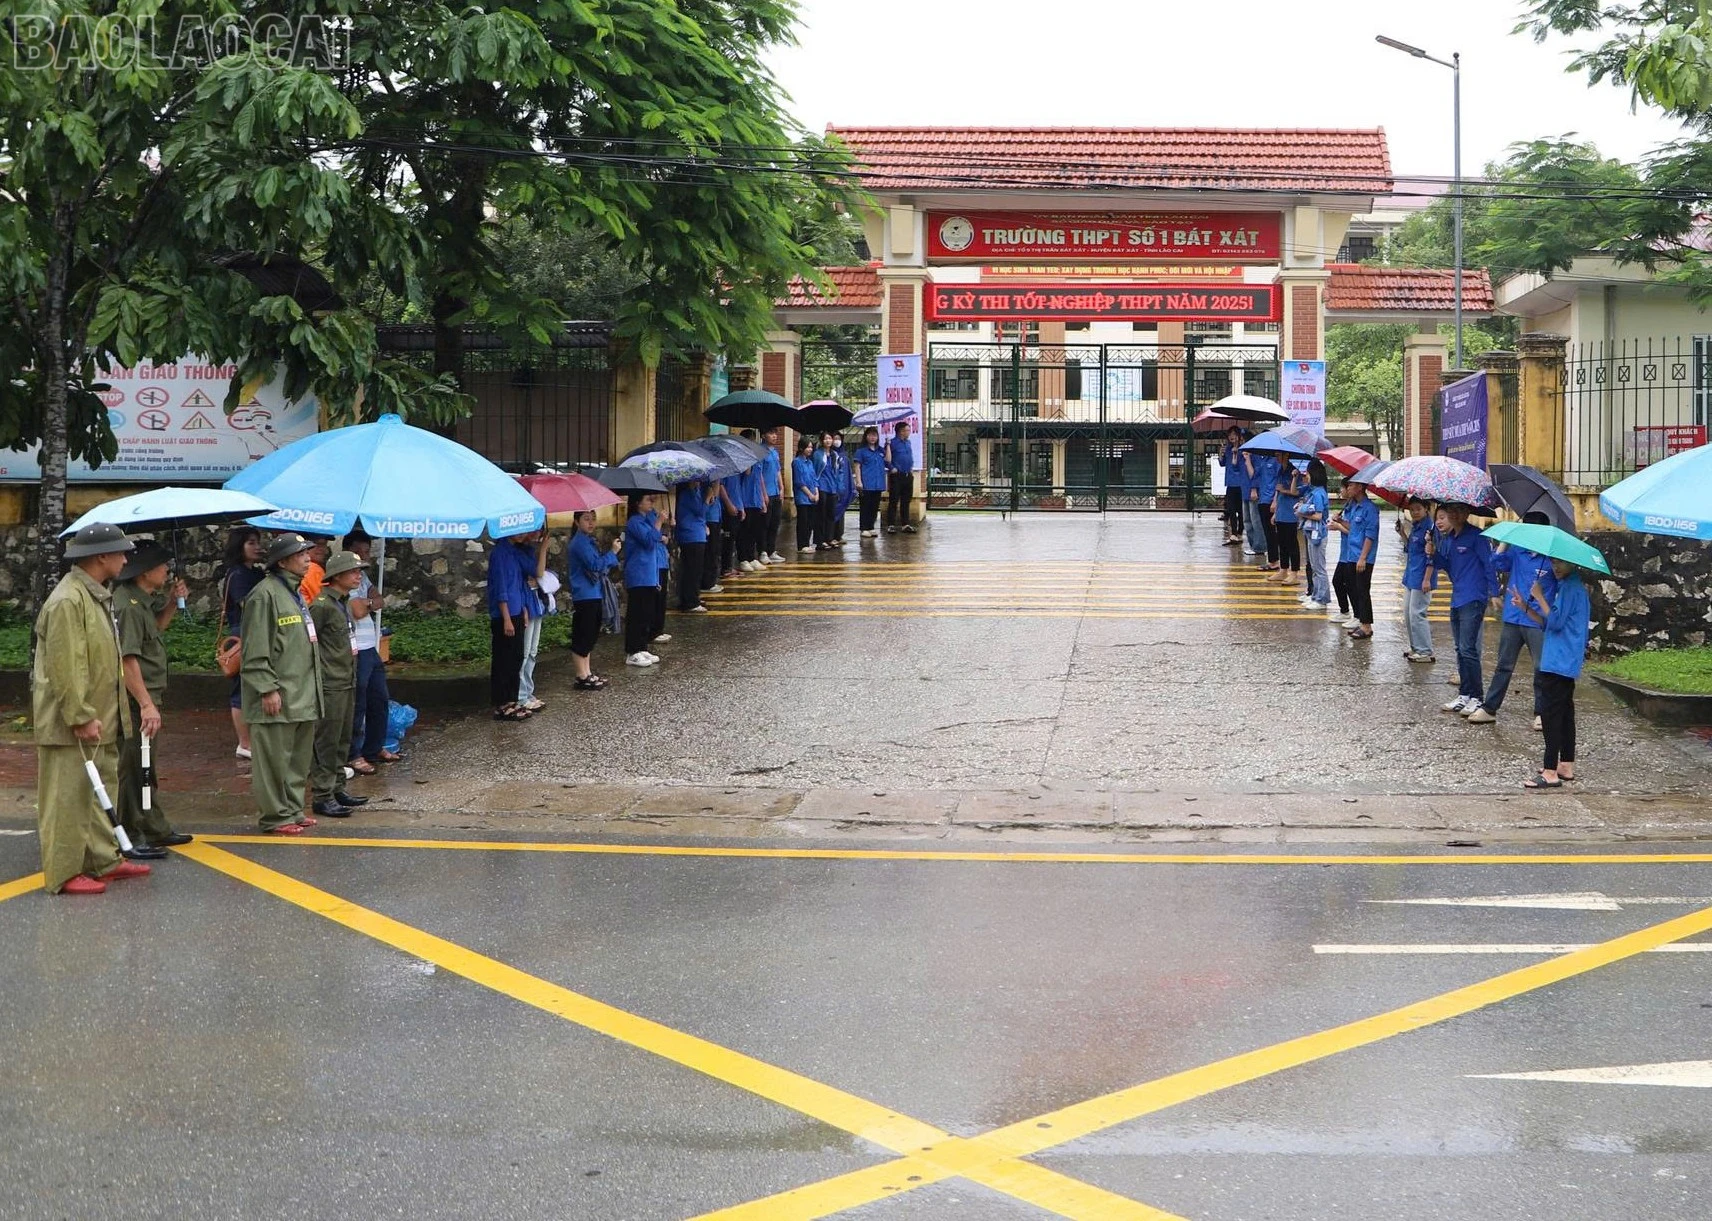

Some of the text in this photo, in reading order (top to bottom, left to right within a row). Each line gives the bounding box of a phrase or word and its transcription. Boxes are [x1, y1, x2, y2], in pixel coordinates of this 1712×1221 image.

[982, 225, 1259, 246] TRƯỜNG THPT SỐ 1 BÁT XÁT
[936, 291, 1253, 312] G KỲ THI TỐT NGHIỆP THPT NĂM 2025!
[139, 364, 178, 380] GIAO
[376, 517, 469, 536] vinaphone
